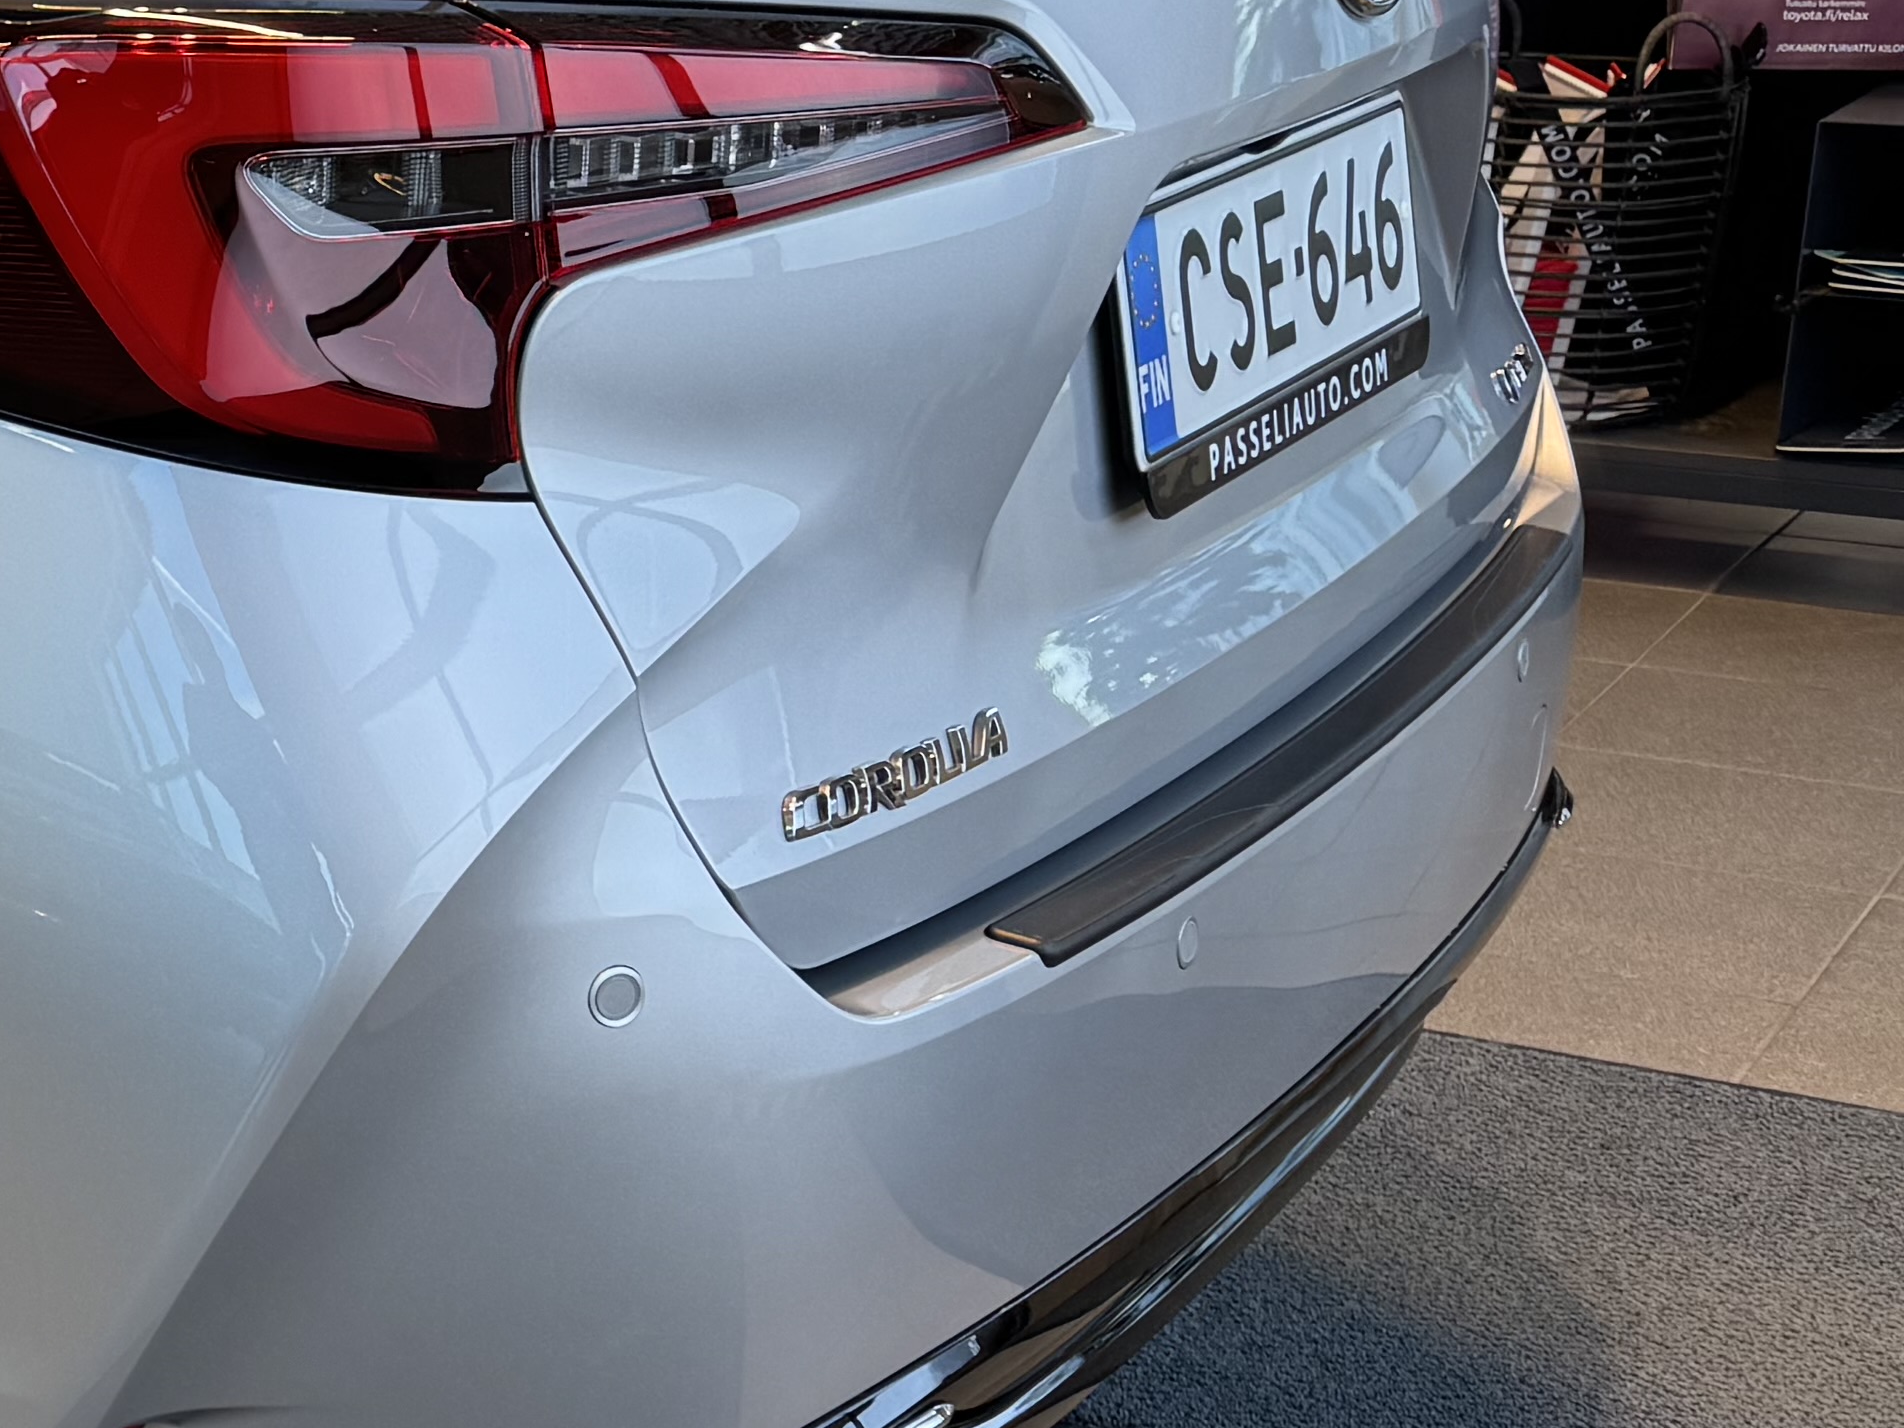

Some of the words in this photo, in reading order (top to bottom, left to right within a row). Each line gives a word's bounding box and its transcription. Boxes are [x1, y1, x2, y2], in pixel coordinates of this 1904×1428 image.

[1775, 43, 1827, 53] JOKAINEN
[1783, 9, 1869, 23] toyota.fi/relax
[1178, 140, 1404, 392] CSE-646
[1138, 354, 1171, 414] FIN
[1209, 347, 1389, 481] PASSELIAUTO.COM
[781, 706, 1010, 842] COROLLA
